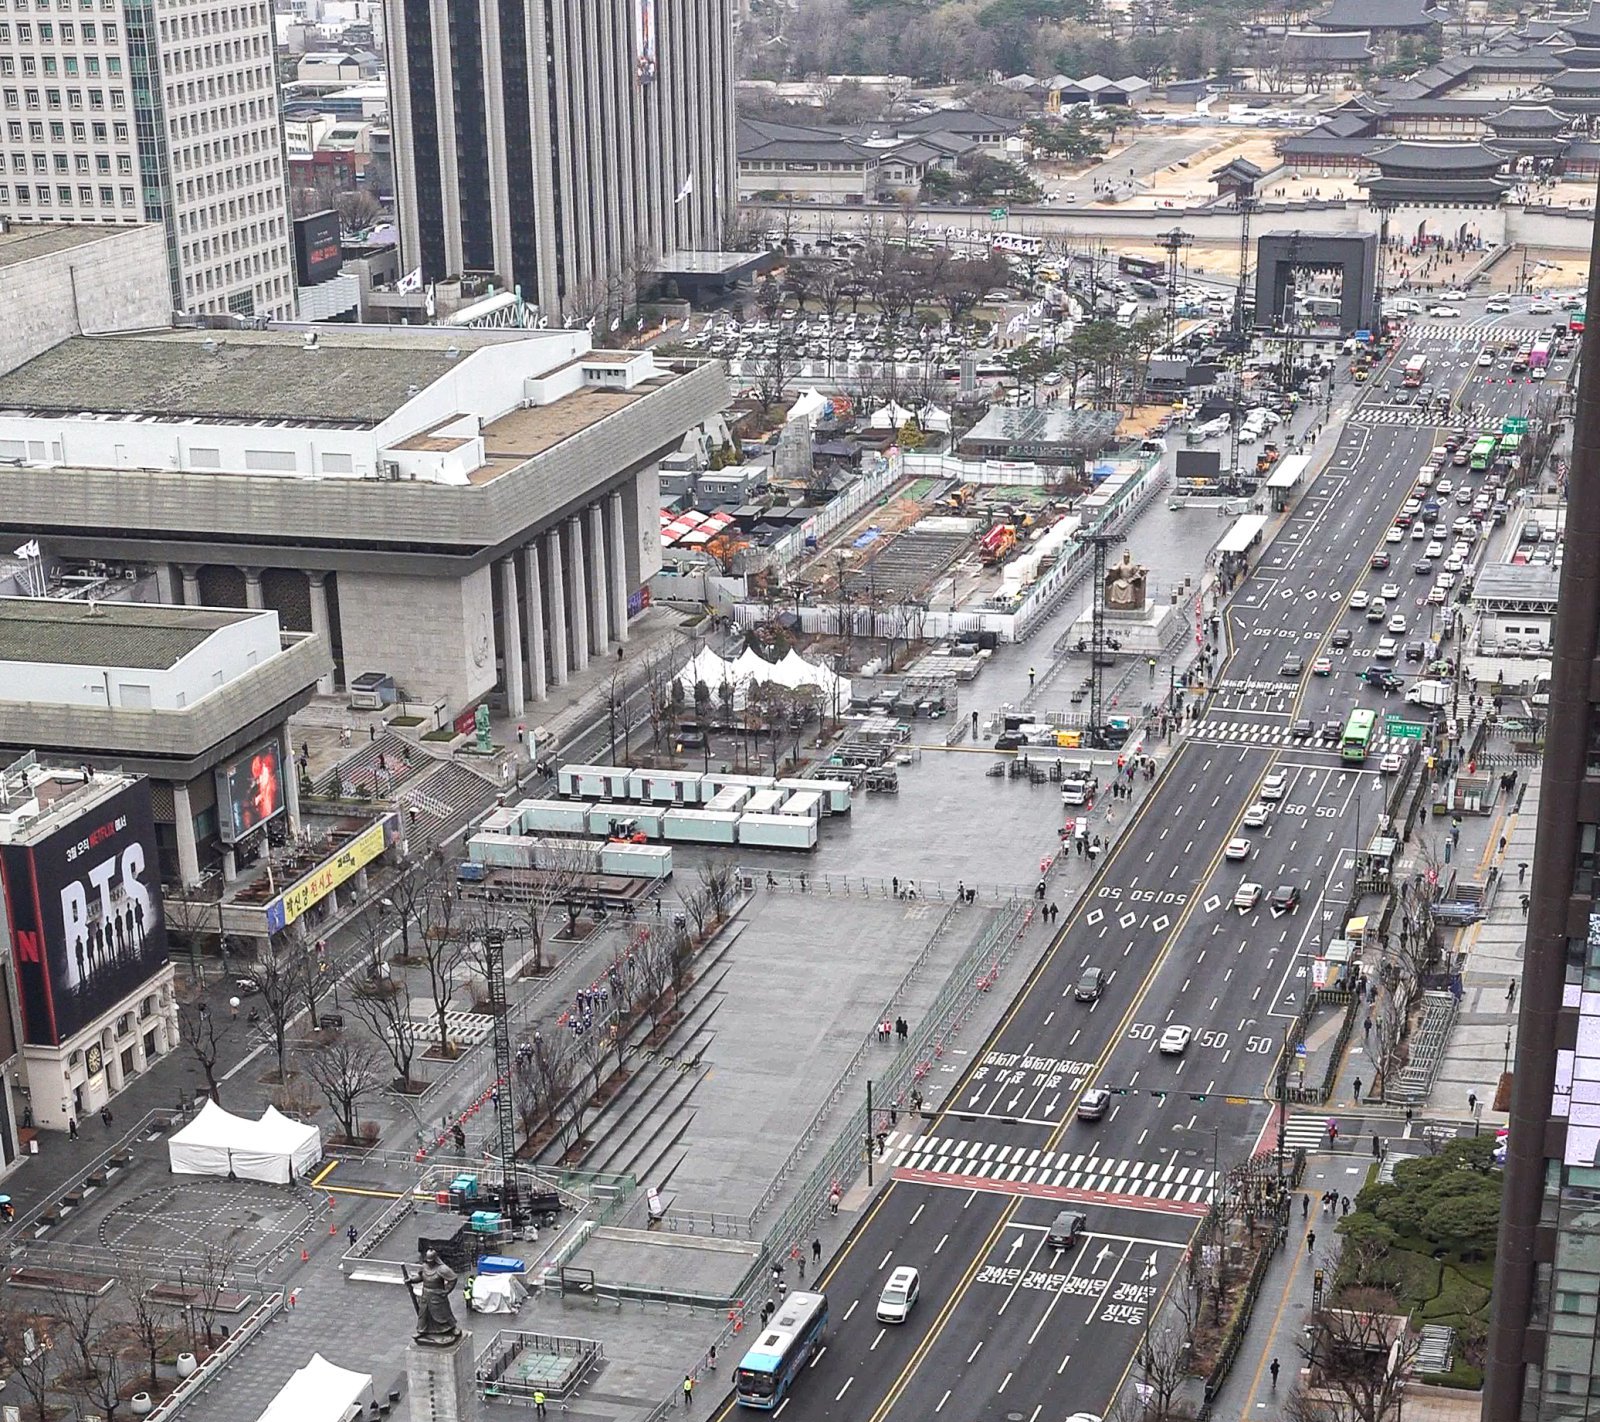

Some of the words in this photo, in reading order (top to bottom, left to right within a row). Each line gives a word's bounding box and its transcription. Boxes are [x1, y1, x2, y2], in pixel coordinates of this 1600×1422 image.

[1284, 804, 1307, 815] 50
[1315, 807, 1337, 818] 50
[1098, 886, 1122, 899] 50
[1130, 890, 1155, 902] 50
[1163, 893, 1187, 905] 50
[60, 842, 150, 985] BTS
[17, 930, 40, 963] N
[1127, 1023, 1156, 1040] 50
[1200, 1031, 1229, 1049] 50
[1245, 1036, 1272, 1055] 50
[1100, 1304, 1147, 1325] 청진동
